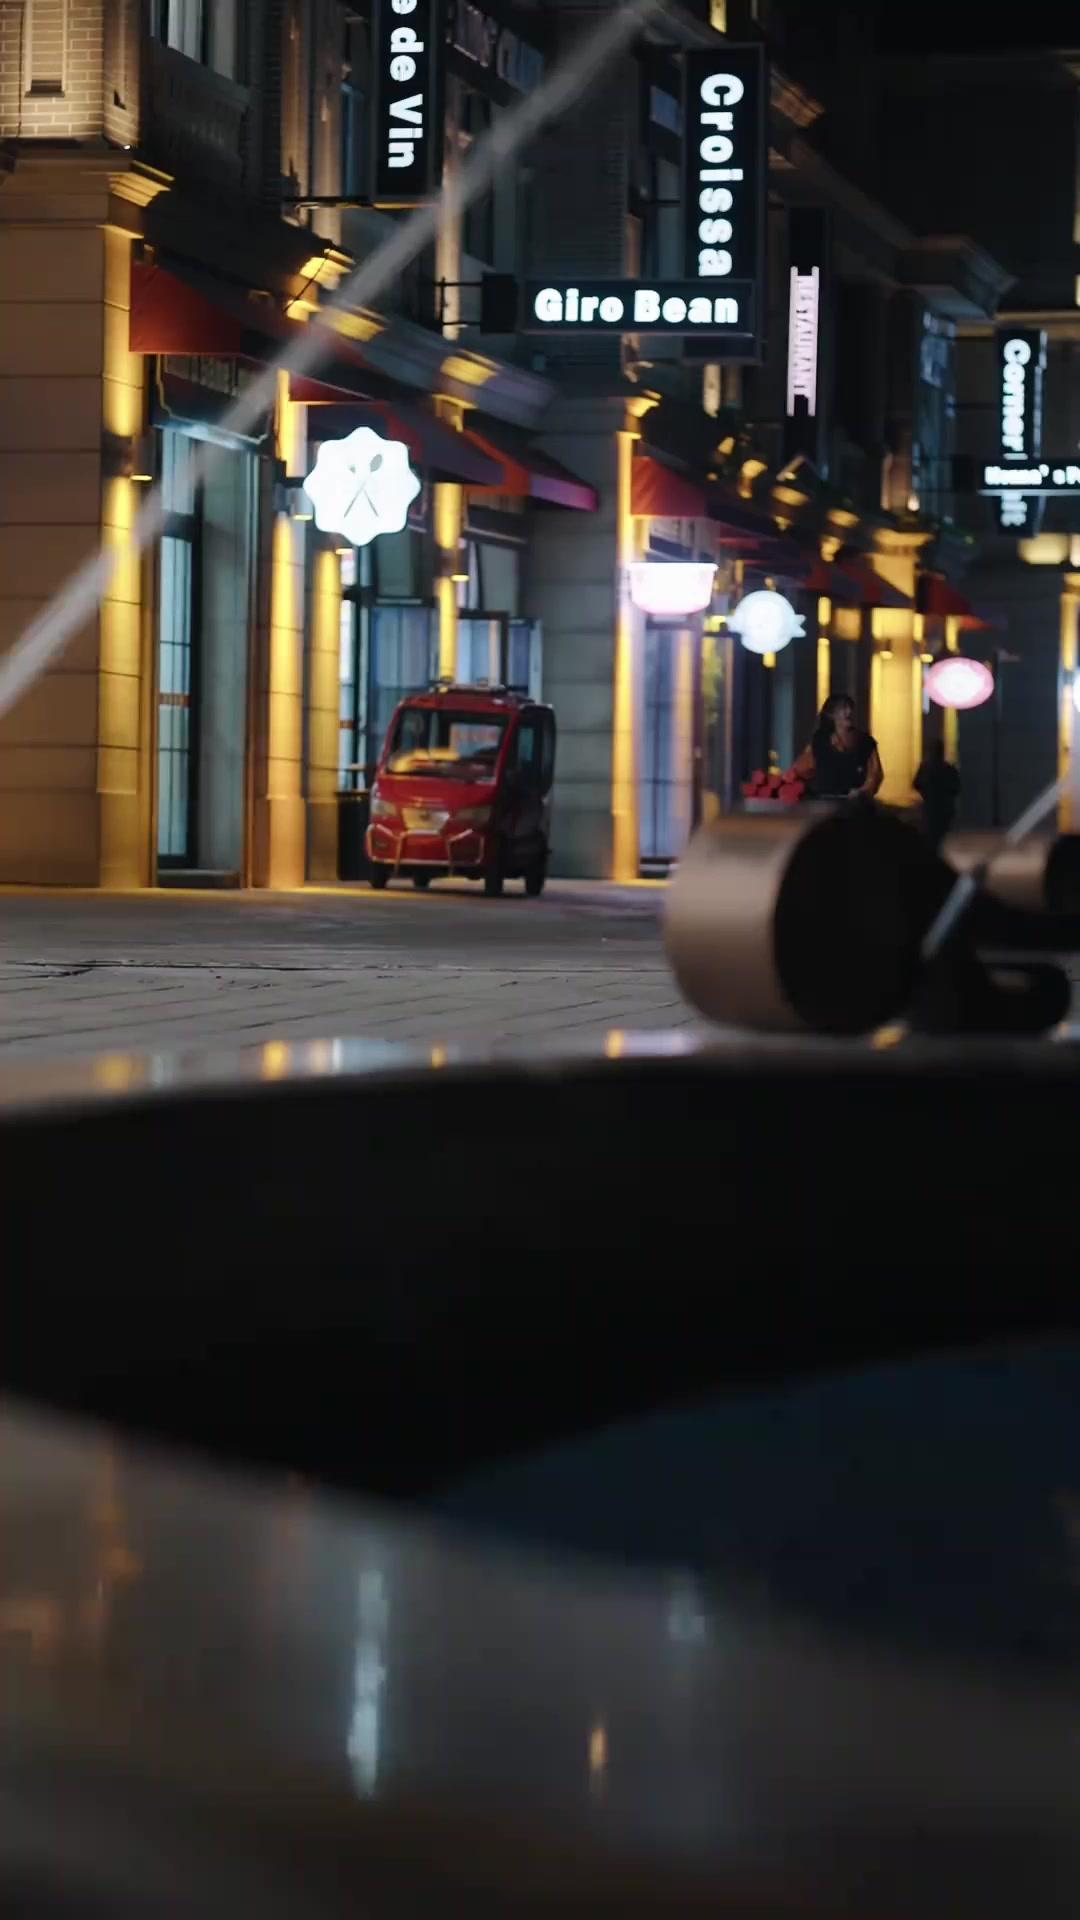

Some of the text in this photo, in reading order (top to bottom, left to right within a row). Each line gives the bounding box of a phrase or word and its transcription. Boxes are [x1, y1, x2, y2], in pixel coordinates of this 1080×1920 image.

[390, 27, 424, 82] de
[388, 93, 424, 168] Vin
[698, 73, 744, 277] Croissa
[535, 288, 738, 323] Giro Bean
[1002, 338, 1031, 452] Corner
